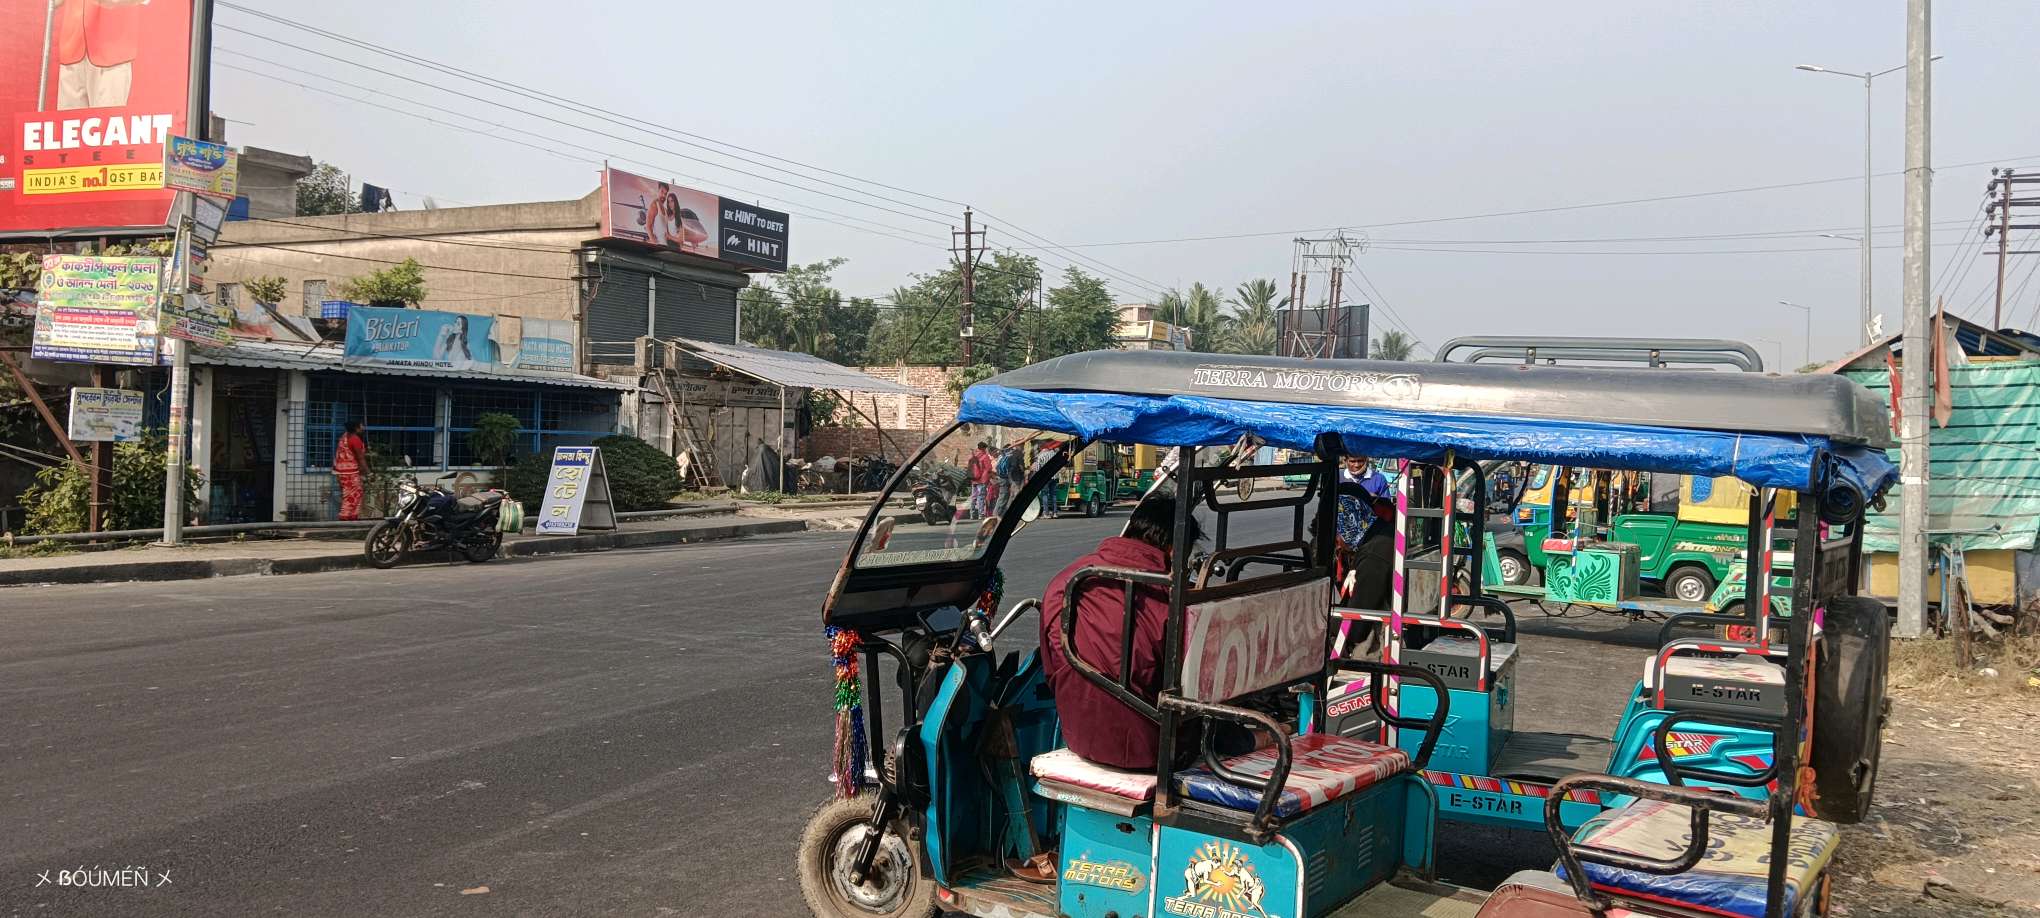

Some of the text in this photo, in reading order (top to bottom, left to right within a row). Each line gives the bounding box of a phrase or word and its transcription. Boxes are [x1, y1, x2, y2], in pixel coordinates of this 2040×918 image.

[24, 114, 172, 150] ELEGANT
[29, 175, 77, 187] INDIA'S
[110, 172, 134, 183] QST
[724, 209, 784, 233] EK HINT TO DETE
[747, 238, 779, 257] HINT
[61, 258, 103, 273] কাকদ্বীপ
[107, 262, 128, 277] ফুল
[130, 262, 157, 274] মেলা
[66, 278, 93, 289] আনন্দ
[365, 316, 420, 341] Bisleri
[1194, 368, 1378, 393] TERRA MOTORS
[1691, 683, 1761, 702] E-STAR
[1450, 793, 1522, 815] E-STAR
[1069, 860, 1128, 877] TERRA
[1064, 871, 1136, 889] MOTORS
[1164, 896, 1216, 918] TERRA
